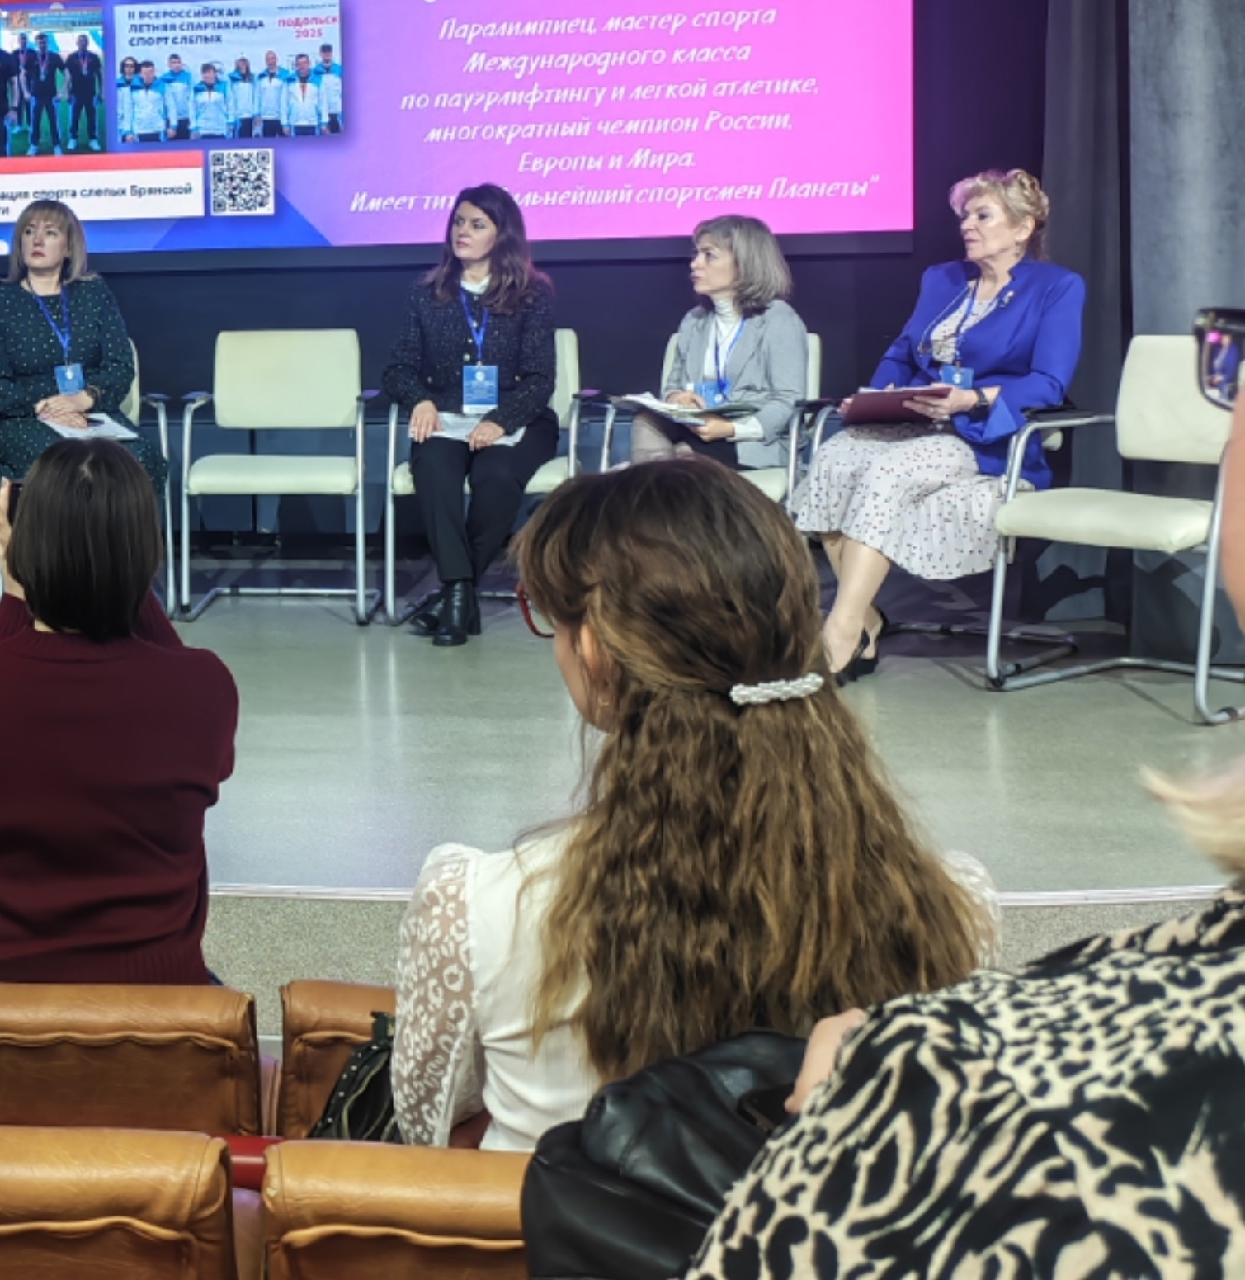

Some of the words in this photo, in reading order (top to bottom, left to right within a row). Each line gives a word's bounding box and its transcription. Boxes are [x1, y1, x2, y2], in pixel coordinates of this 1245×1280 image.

[128, 23, 177, 33] ЛЕТНЯЯ
[178, 20, 265, 32] СПАРТАКИАДА
[138, 7, 241, 19] ВСЕРОССИЙСКАЯ
[602, 13, 687, 36] мастер
[692, 8, 777, 33] спорта
[128, 36, 170, 47] СПОРТ
[171, 34, 222, 45] СЛЕПЫХ
[463, 49, 666, 79] Международного
[672, 45, 751, 64] класса
[401, 93, 429, 110] по
[434, 82, 606, 112] пауэрлифтингу
[611, 86, 625, 101] и
[630, 78, 708, 100] легкой
[424, 116, 592, 145] многократный
[597, 117, 699, 135] чемпион
[517, 152, 602, 178] Европы
[608, 152, 622, 169] и
[32, 189, 77, 201] спорта
[80, 187, 126, 197] слепых
[129, 182, 192, 199] Брянской
[350, 192, 417, 213] Имеет
[423, 195, 456, 210] тит
[635, 183, 763, 209] спортсмен
